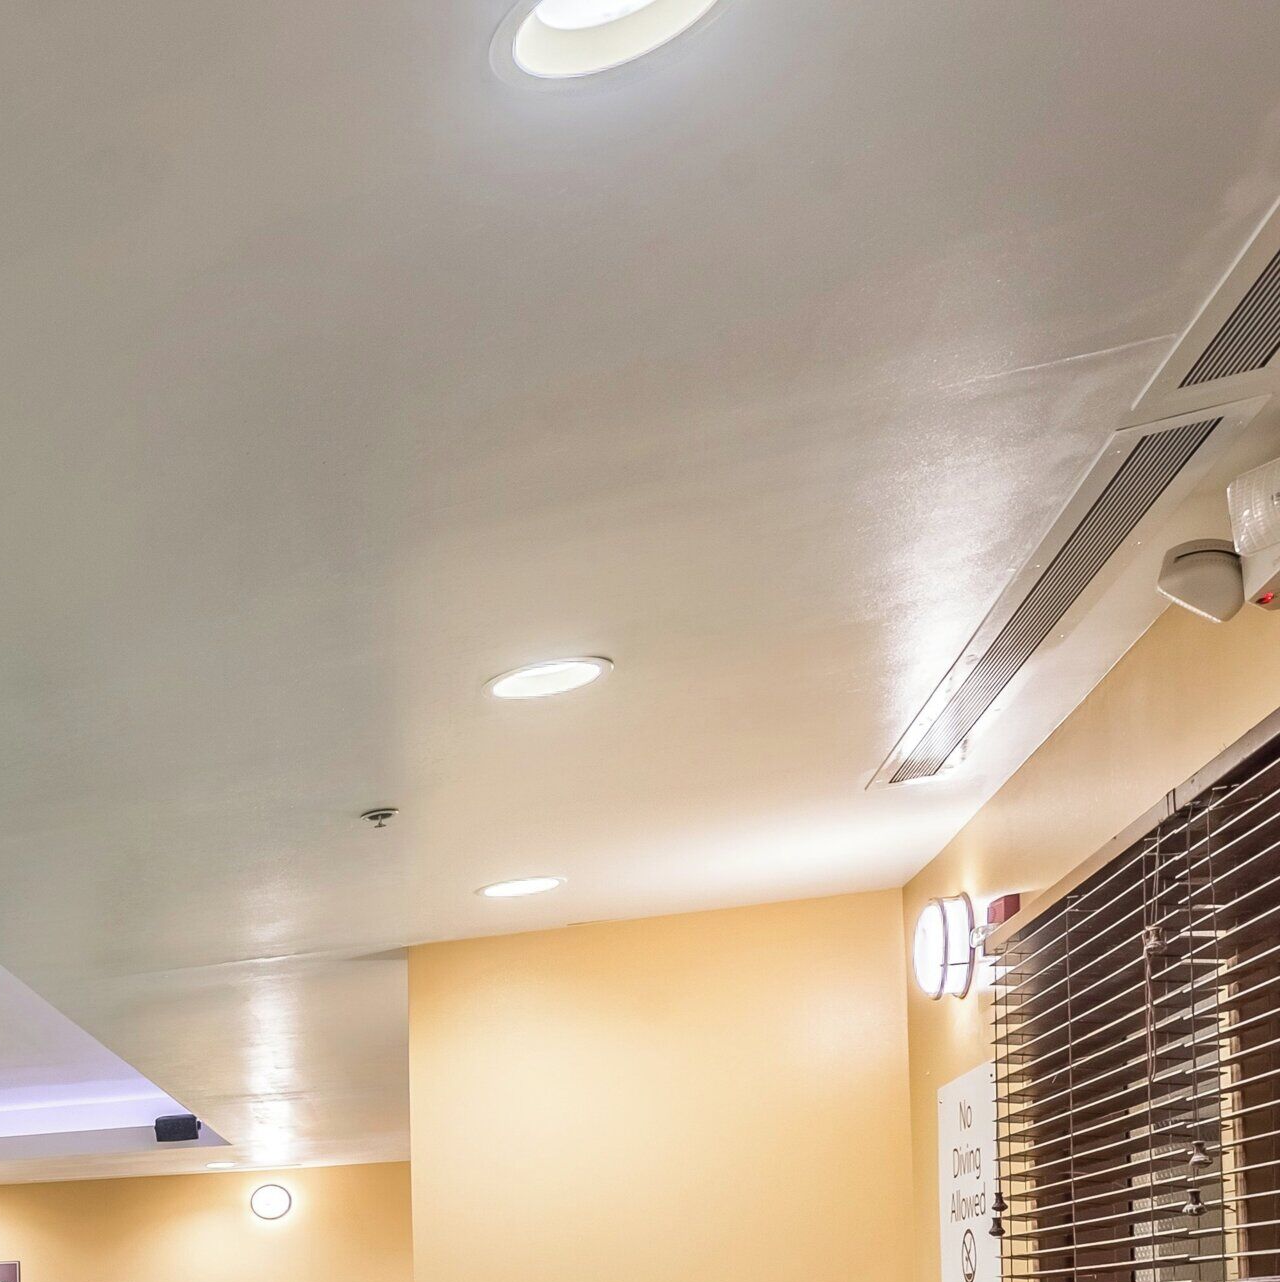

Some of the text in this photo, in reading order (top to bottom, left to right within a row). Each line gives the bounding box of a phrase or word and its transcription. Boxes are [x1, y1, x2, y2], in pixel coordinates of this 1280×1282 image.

[959, 1100, 972, 1131] No
[953, 1144, 981, 1179] Diving
[950, 1182, 986, 1223] Allowed
